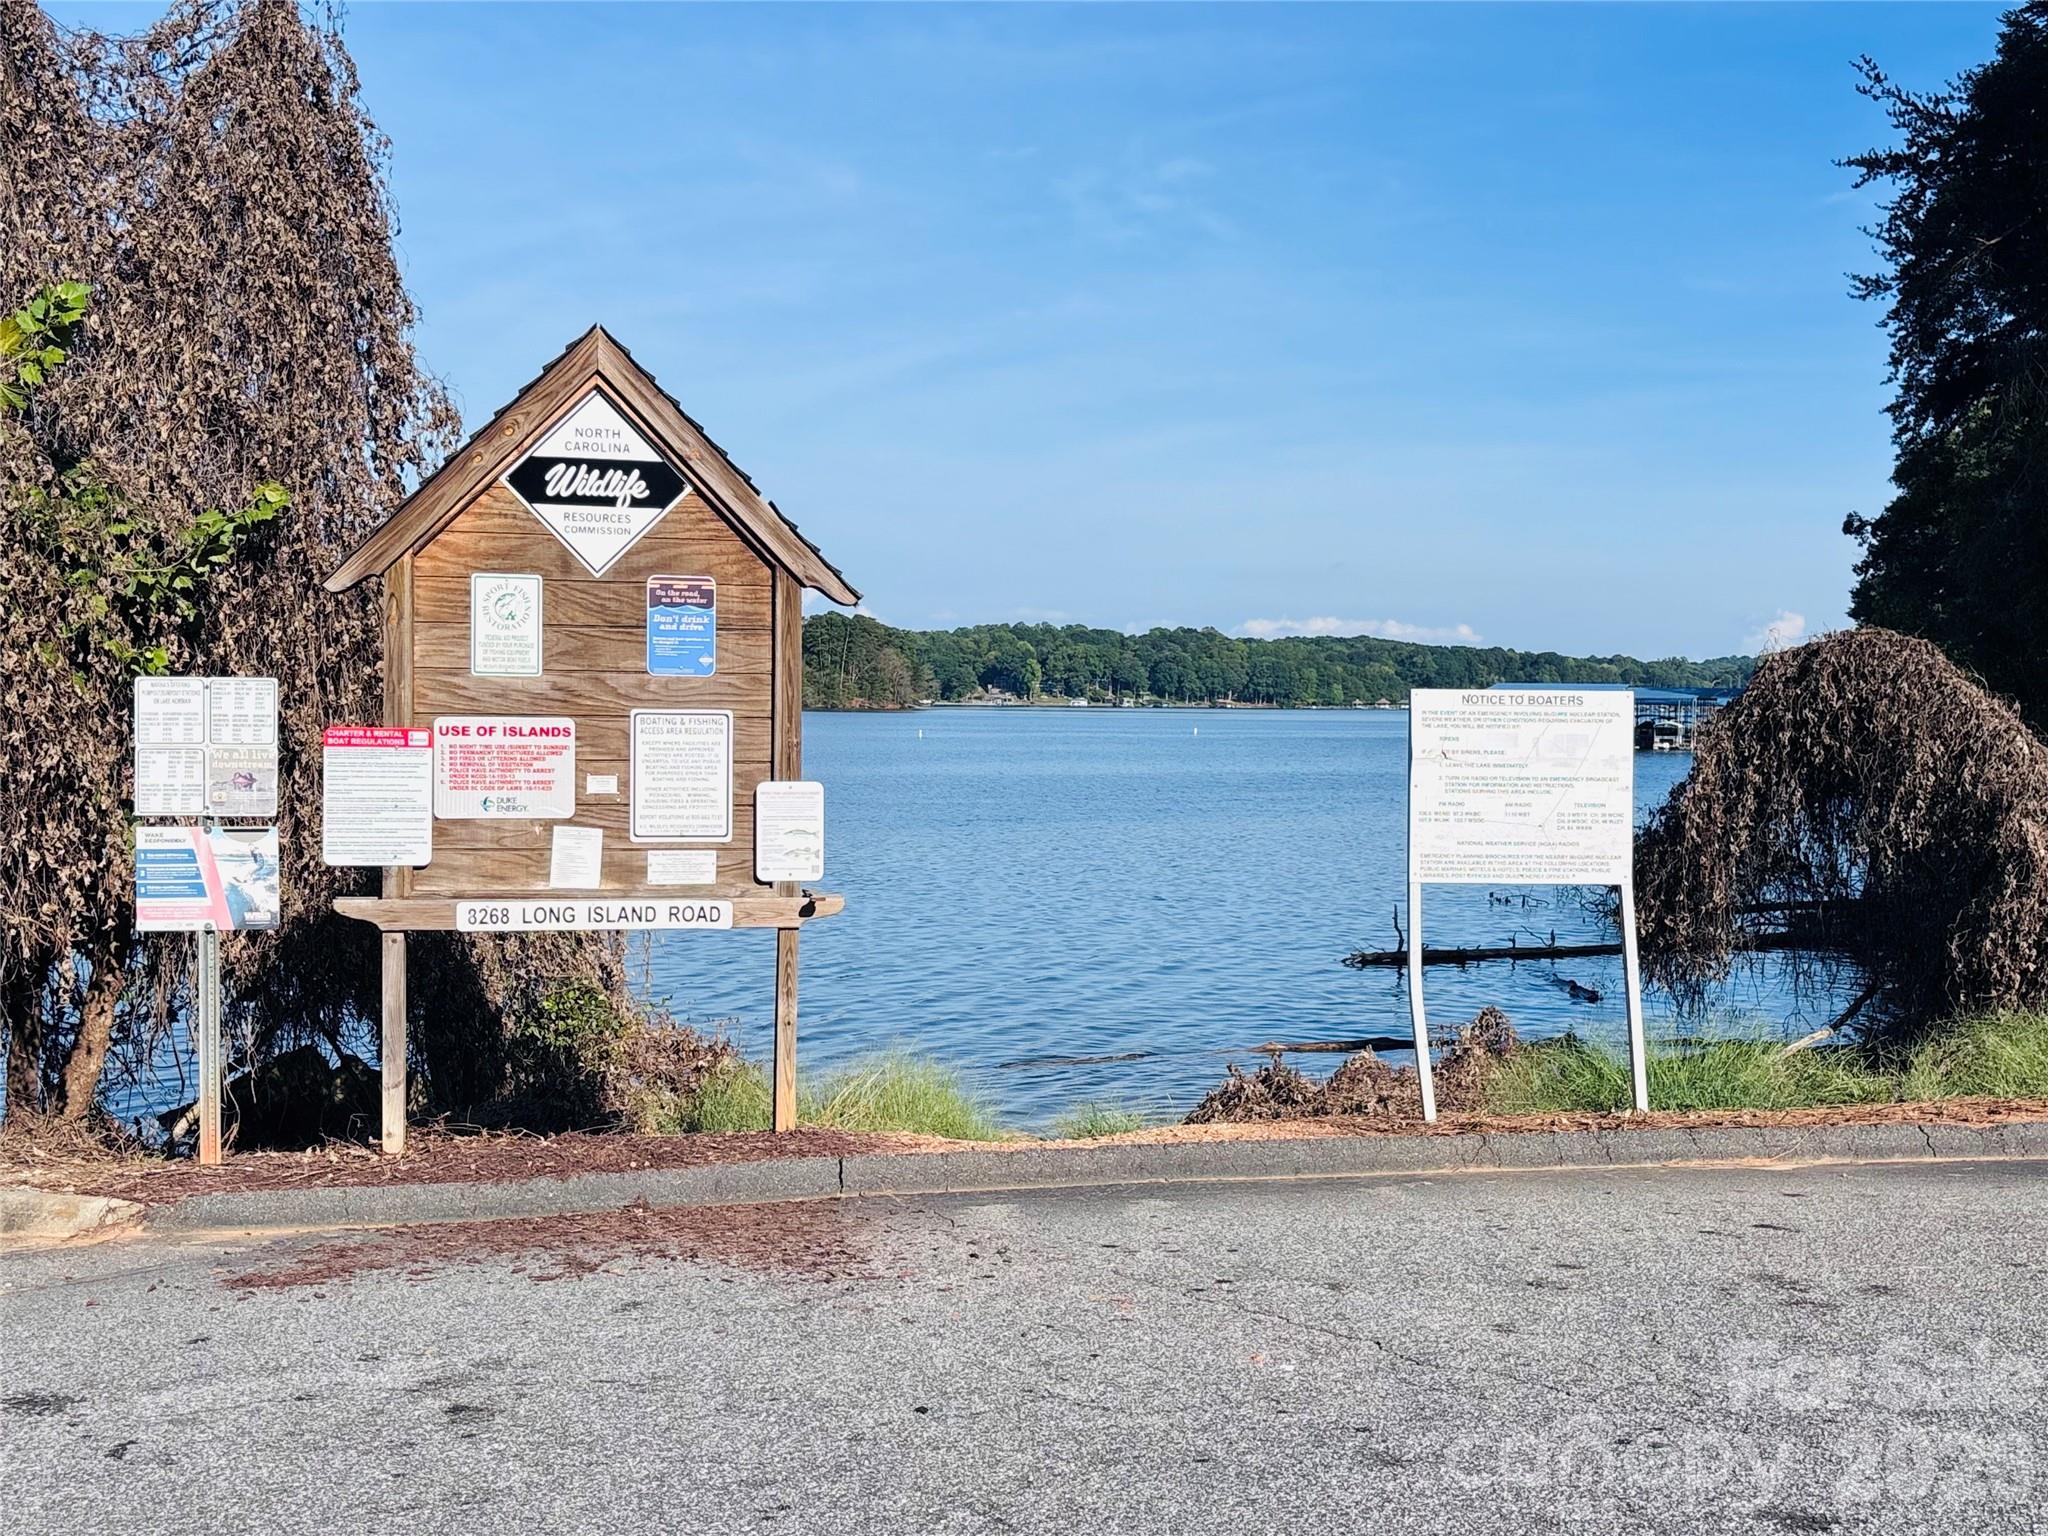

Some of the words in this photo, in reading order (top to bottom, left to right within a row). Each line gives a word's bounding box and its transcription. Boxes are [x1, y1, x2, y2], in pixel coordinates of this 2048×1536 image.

[575, 428, 621, 438] NORTH
[564, 441, 630, 454] CAROLINA
[544, 462, 650, 508] Wildlife
[563, 512, 632, 524] RESOURCES
[564, 526, 632, 536] COMMISSION
[654, 614, 678, 623] Don't
[681, 616, 710, 624] drink
[1462, 694, 1506, 705] NOTICE
[1508, 695, 1524, 705] TO
[1528, 695, 1584, 706] BOATERS
[640, 717, 677, 726] BOATING
[680, 717, 686, 726] &
[688, 717, 724, 726] FISHING
[439, 726, 471, 737] USE
[476, 726, 497, 737] OF
[502, 726, 572, 737] ISLANDS
[640, 727, 664, 735] ACCESS
[666, 727, 682, 735] AREA
[213, 750, 229, 759] We
[234, 750, 252, 760] all
[255, 750, 275, 760] live
[467, 908, 510, 925] 8268
[522, 907, 576, 924] LONG
[588, 906, 657, 923] ISLAND
[668, 906, 721, 922] ROAD
